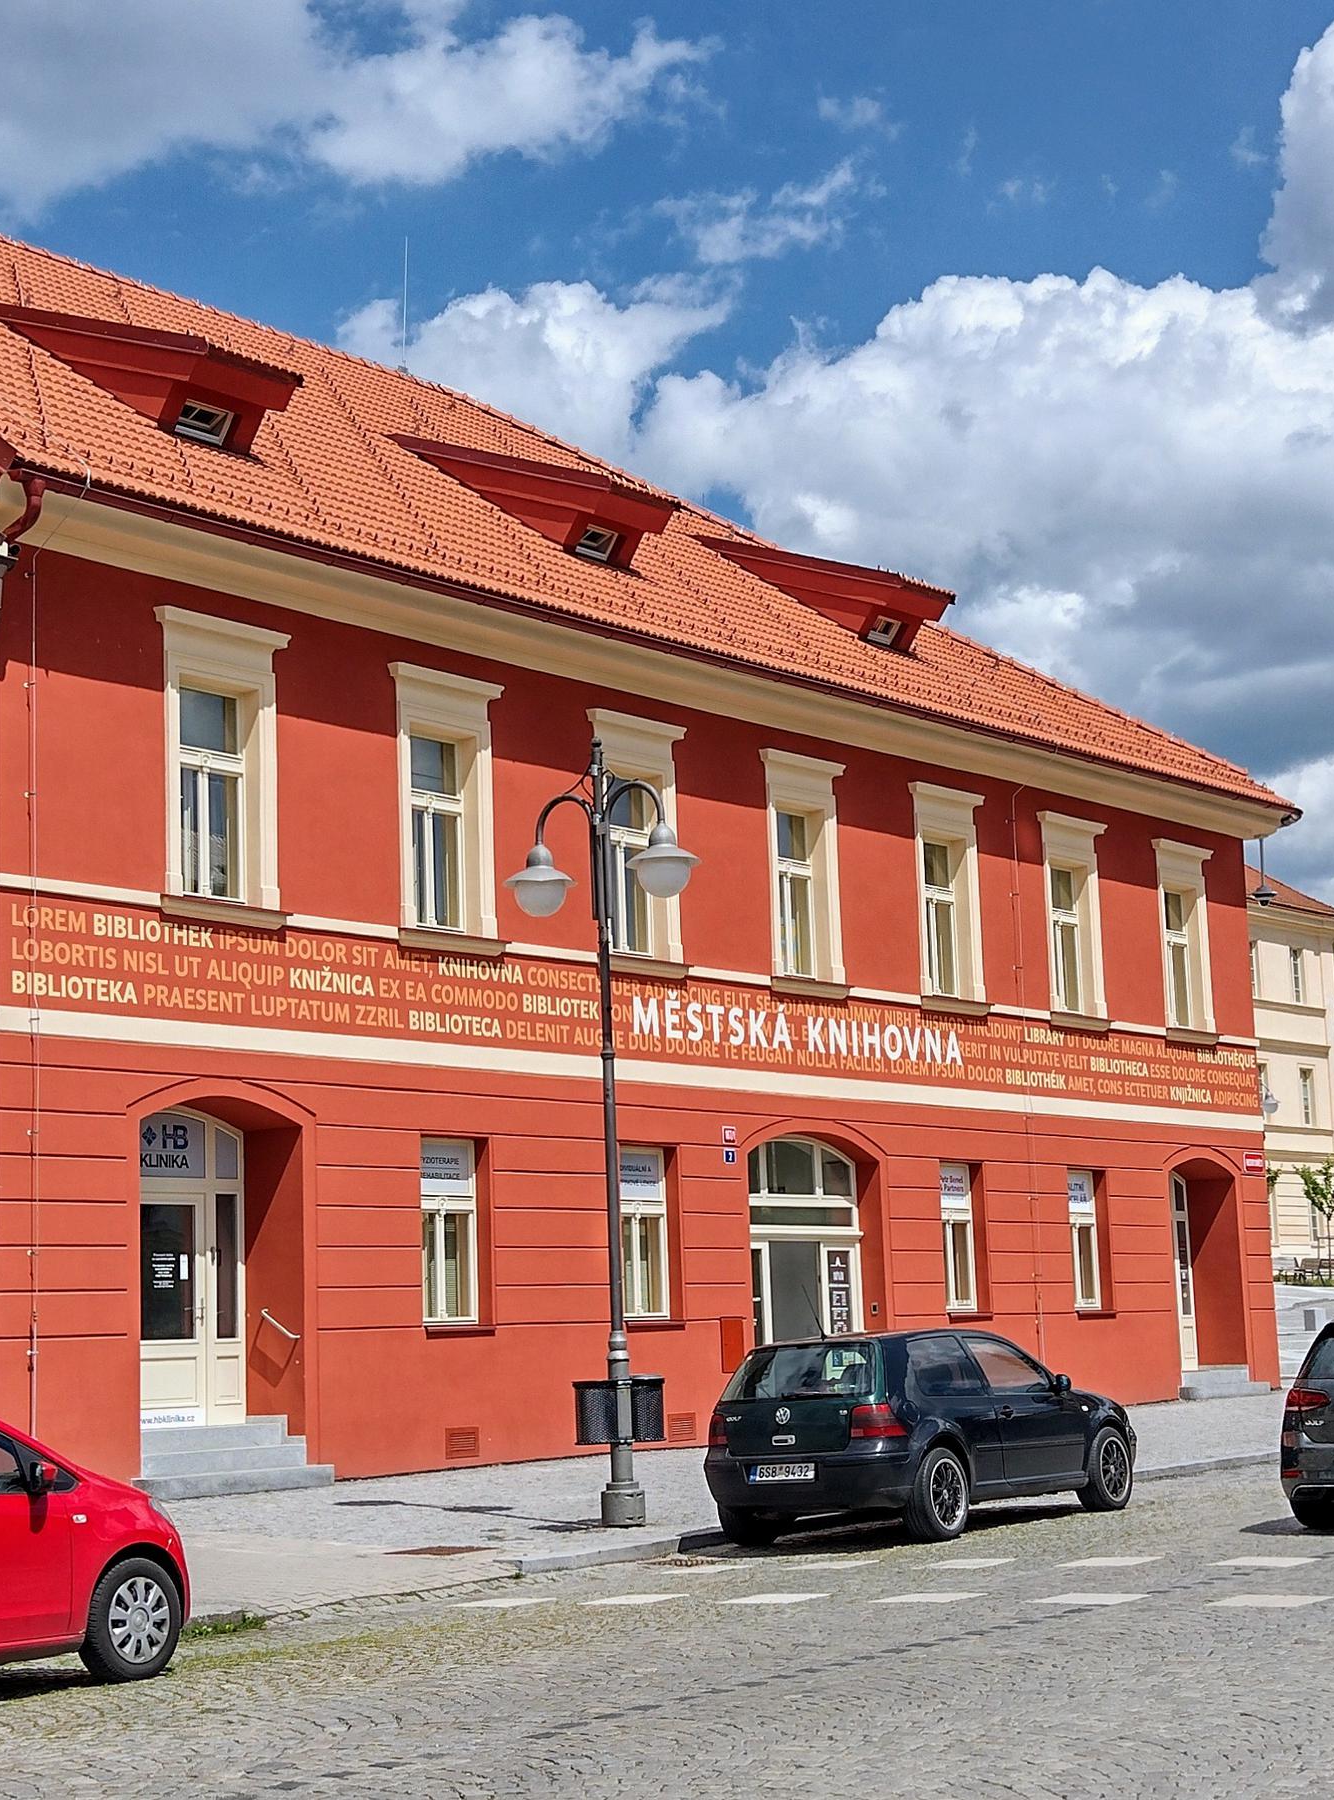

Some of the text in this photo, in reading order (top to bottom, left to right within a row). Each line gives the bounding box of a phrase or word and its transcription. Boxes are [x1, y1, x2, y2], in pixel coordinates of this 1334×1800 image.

[11, 936, 117, 970] LOBORTIS
[123, 950, 169, 976] NISL
[174, 955, 202, 979] UT
[206, 961, 285, 990] ALIQUIP
[289, 965, 375, 998] KNIŽNICA
[379, 977, 401, 1000] EX
[405, 982, 427, 1003] EA
[430, 983, 518, 1013] COMMODO
[522, 993, 599, 1020] BIBLIOTEK
[11, 904, 87, 934] LOREM
[93, 913, 214, 949] BIBLIOTHEK
[219, 928, 279, 956] IPSUM
[285, 939, 347, 964] DOLOR
[352, 945, 378, 968] SIT
[383, 949, 433, 978] AMET,
[438, 955, 524, 985] KNIHOVNA
[527, 966, 640, 997] CONSECTEUER
[757, 993, 781, 1014] SED
[784, 999, 816, 1018] DIAM
[819, 1001, 881, 1024] NONUMMY
[884, 1011, 912, 1028] NIBH
[917, 1013, 965, 1034] EUISMOD
[966, 1016, 1022, 1041] TINCIDUNT
[1024, 1026, 1065, 1047] LIBRARY
[1067, 1031, 1081, 1048] UT
[1082, 1033, 1120, 1053] DOLORE
[1122, 1039, 1155, 1058] MAGNA
[1156, 1043, 1196, 1063] ALIQUAM
[1197, 1047, 1257, 1071] BIBLIOTHÈQUE
[11, 970, 138, 1005] BIBLIOTEKA
[143, 983, 245, 1014] PRAESENT
[250, 994, 350, 1024] LUPTATUM
[355, 1004, 404, 1029] ZZRIL
[408, 1011, 503, 1039] BIBLIOTECA
[506, 1019, 570, 1045] DELENIT
[628, 1033, 662, 1053] DUIS
[667, 1038, 721, 1059] DOLORE
[722, 1041, 739, 1060] TE
[741, 1043, 792, 1065] FEUGAIT
[796, 1048, 838, 1069] NULLA
[891, 1059, 929, 1077] LOREM
[931, 1063, 965, 1080] IPSUM
[967, 1065, 1004, 1084] DOLOR
[1006, 1069, 1067, 1090] BIBLIOTHÉIK
[1068, 1076, 1096, 1096] AMET,
[1098, 1078, 1123, 1095] CONS
[1125, 1082, 1168, 1099] ECTETUER
[1170, 1084, 1212, 1104] KNJIŽNICA
[1213, 1090, 1258, 1108] ADIPISCING
[632, 988, 964, 1066] MĚSTSKÁ KNIHOVNA
[990, 1045, 1001, 1061] IN
[1002, 1046, 1061, 1069] VULPUTATE
[1061, 1053, 1089, 1071] VELIT
[1090, 1056, 1149, 1078] BIBLIOTHECA
[1150, 1063, 1171, 1080] ESSE
[1172, 1066, 1207, 1083] DOLORE
[1208, 1069, 1257, 1091] CONSEQUAT,
[161, 1124, 189, 1150] HB
[140, 1153, 190, 1169] KLINIKA
[140, 1415, 195, 1425] ww.hbklinika.cz
[784, 1465, 810, 1478] 9432
